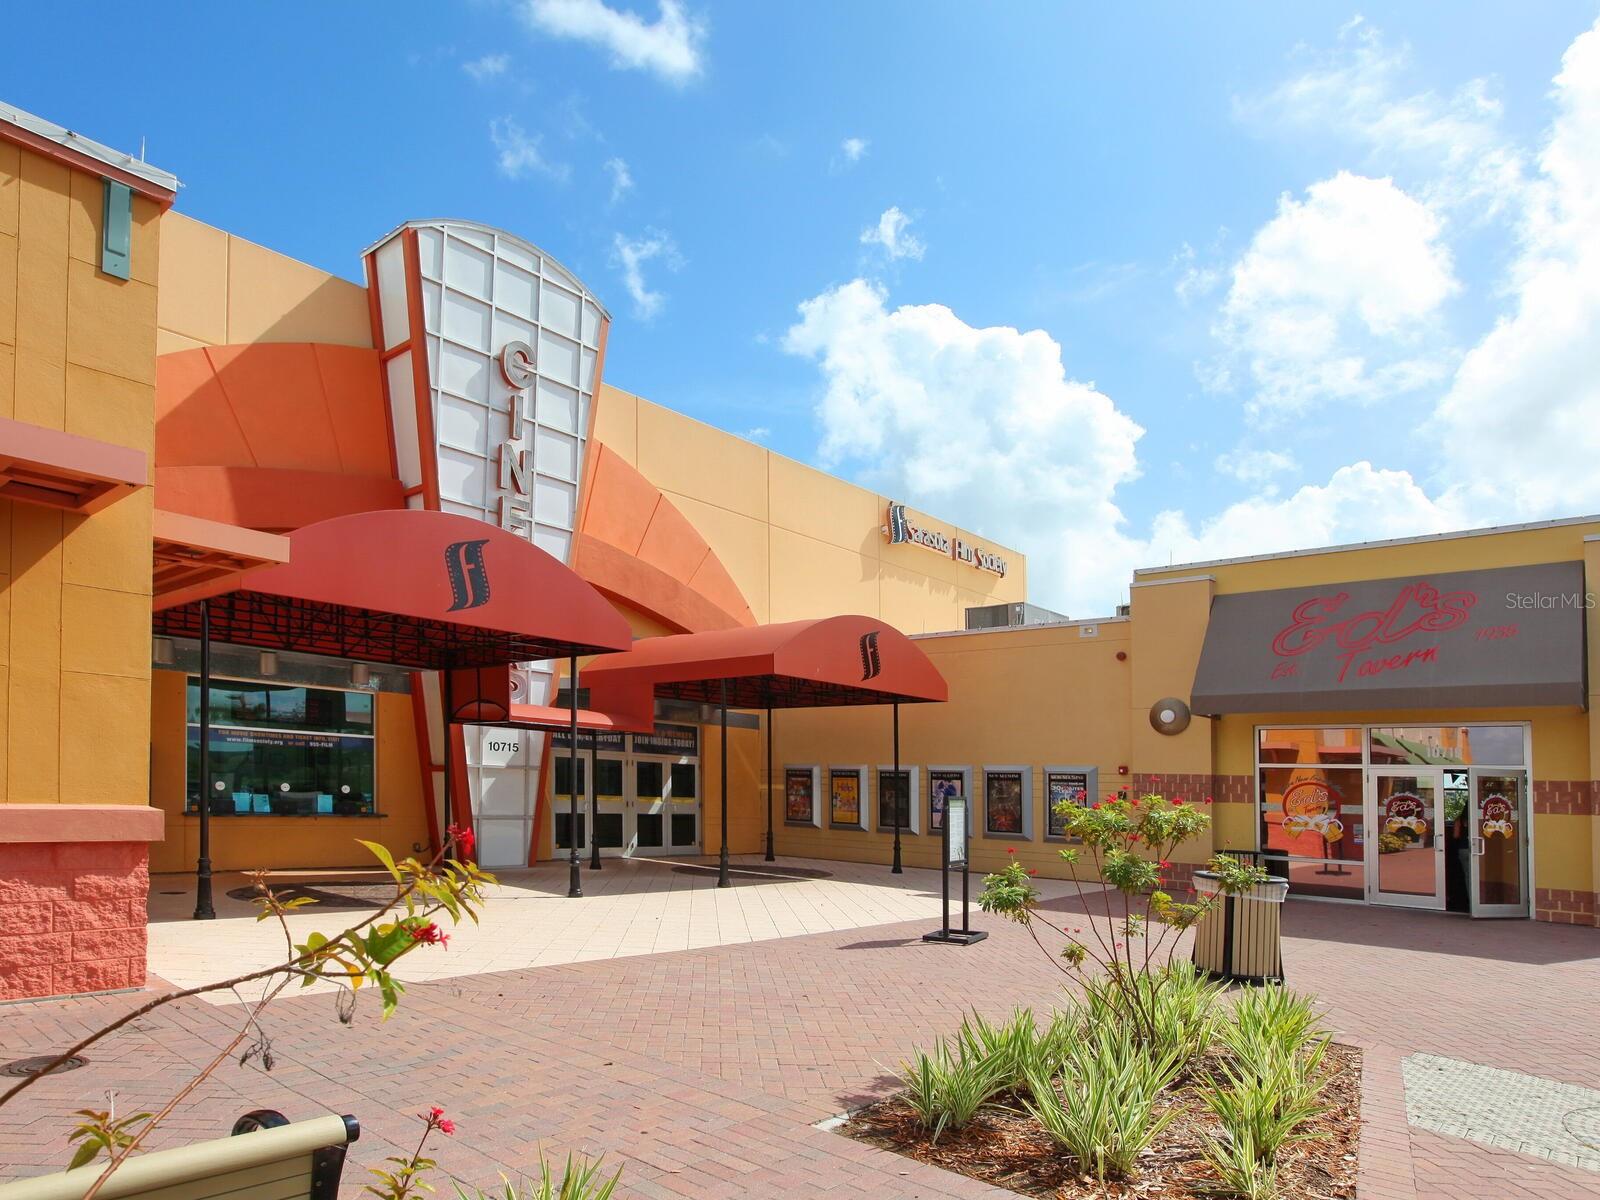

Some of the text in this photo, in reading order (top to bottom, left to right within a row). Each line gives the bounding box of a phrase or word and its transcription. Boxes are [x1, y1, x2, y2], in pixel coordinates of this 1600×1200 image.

[1335, 645, 1440, 683] Tavern
[634, 735, 649, 745] JOIN
[488, 741, 519, 752] 10715
